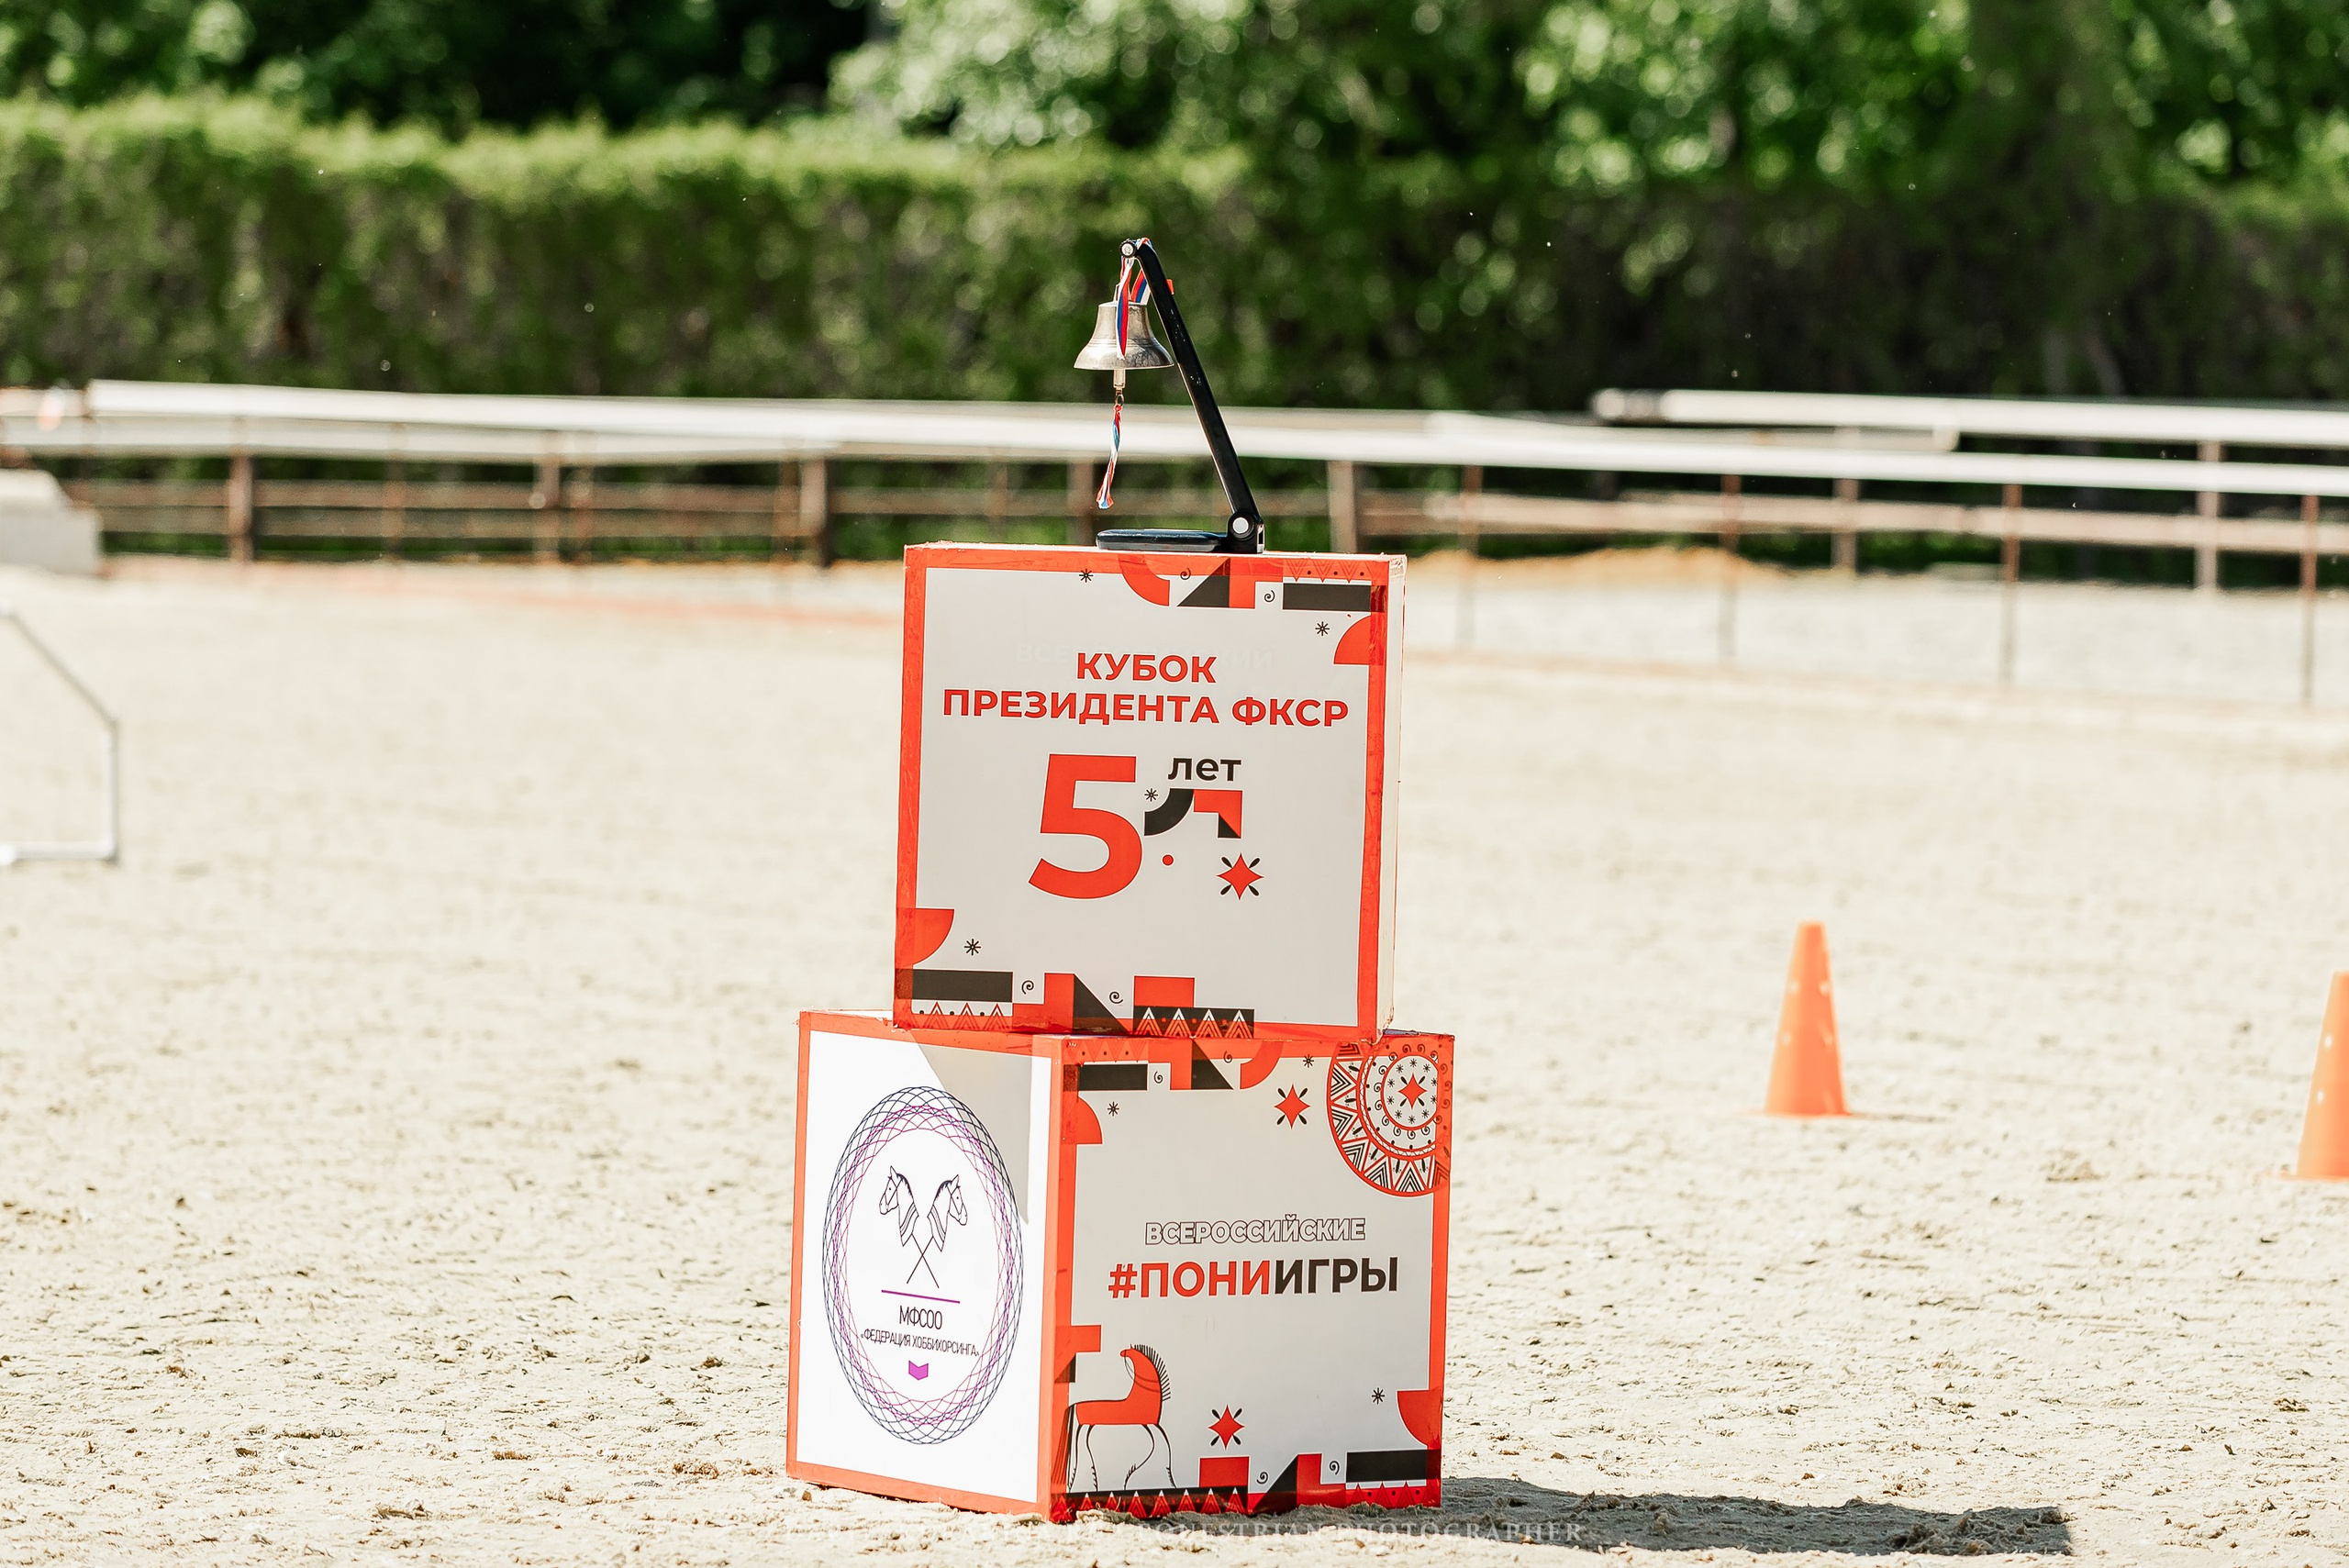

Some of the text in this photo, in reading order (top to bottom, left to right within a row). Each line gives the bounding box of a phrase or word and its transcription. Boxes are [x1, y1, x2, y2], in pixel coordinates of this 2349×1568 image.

[1077, 653, 1217, 684] КУБОК
[943, 689, 1349, 727] ПРЕЗИДЕНТА ФКСР
[1029, 754, 1241, 899] 5 лет
[1145, 1215, 1366, 1245] ВСЕРОССИЙСКИЕ
[1108, 1257, 1398, 1299] #ПОНИИГРЫ
[899, 1305, 943, 1330] МФСОО
